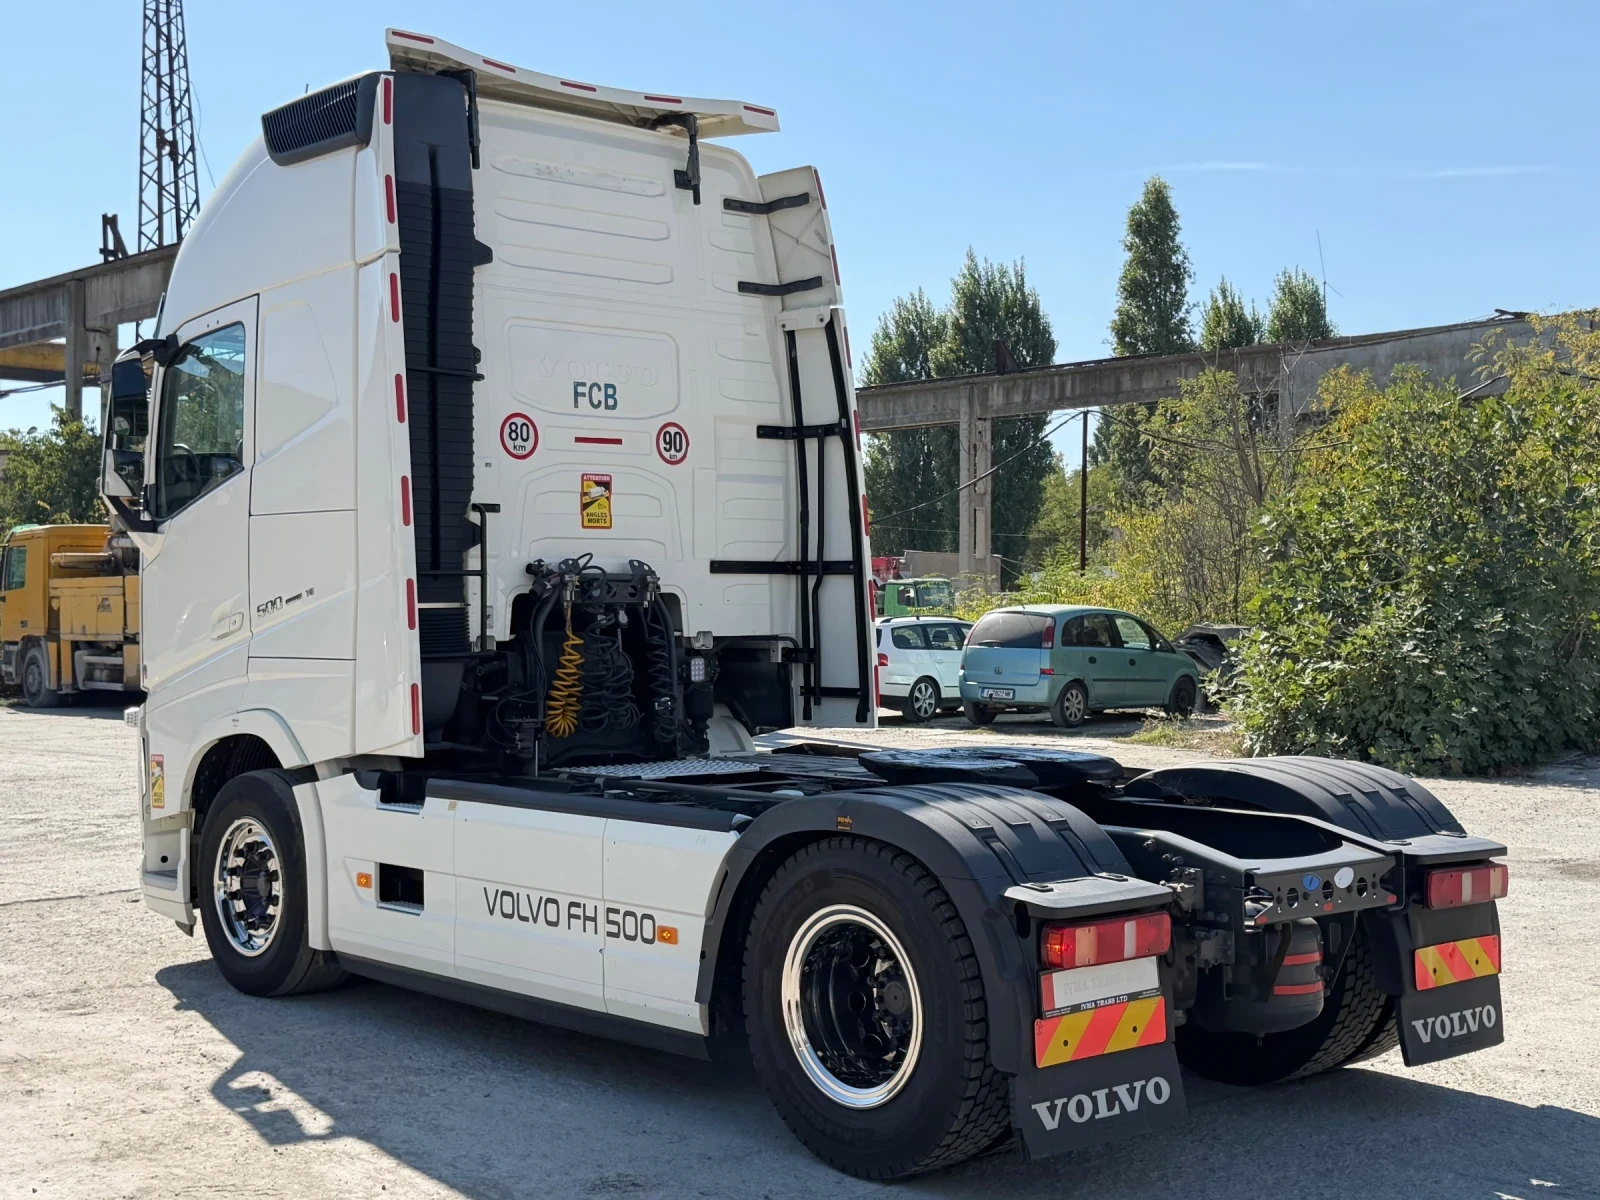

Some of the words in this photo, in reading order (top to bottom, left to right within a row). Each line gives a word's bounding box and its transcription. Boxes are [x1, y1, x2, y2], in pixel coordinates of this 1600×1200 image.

[539, 357, 659, 387] VOLVO
[573, 381, 618, 410] FCB
[508, 421, 530, 442] 80
[662, 430, 683, 453] 90
[513, 442, 526, 452] km
[257, 596, 283, 618] 500
[483, 886, 560, 928] VOLVO
[567, 901, 598, 935] FH
[605, 907, 656, 945] 500
[1081, 1002, 1096, 1011] IVMA
[1096, 997, 1116, 1007] TRANS
[1116, 995, 1128, 1004] LTD
[1412, 1005, 1496, 1044] VOLVO
[1032, 1076, 1170, 1131] VOLVO
